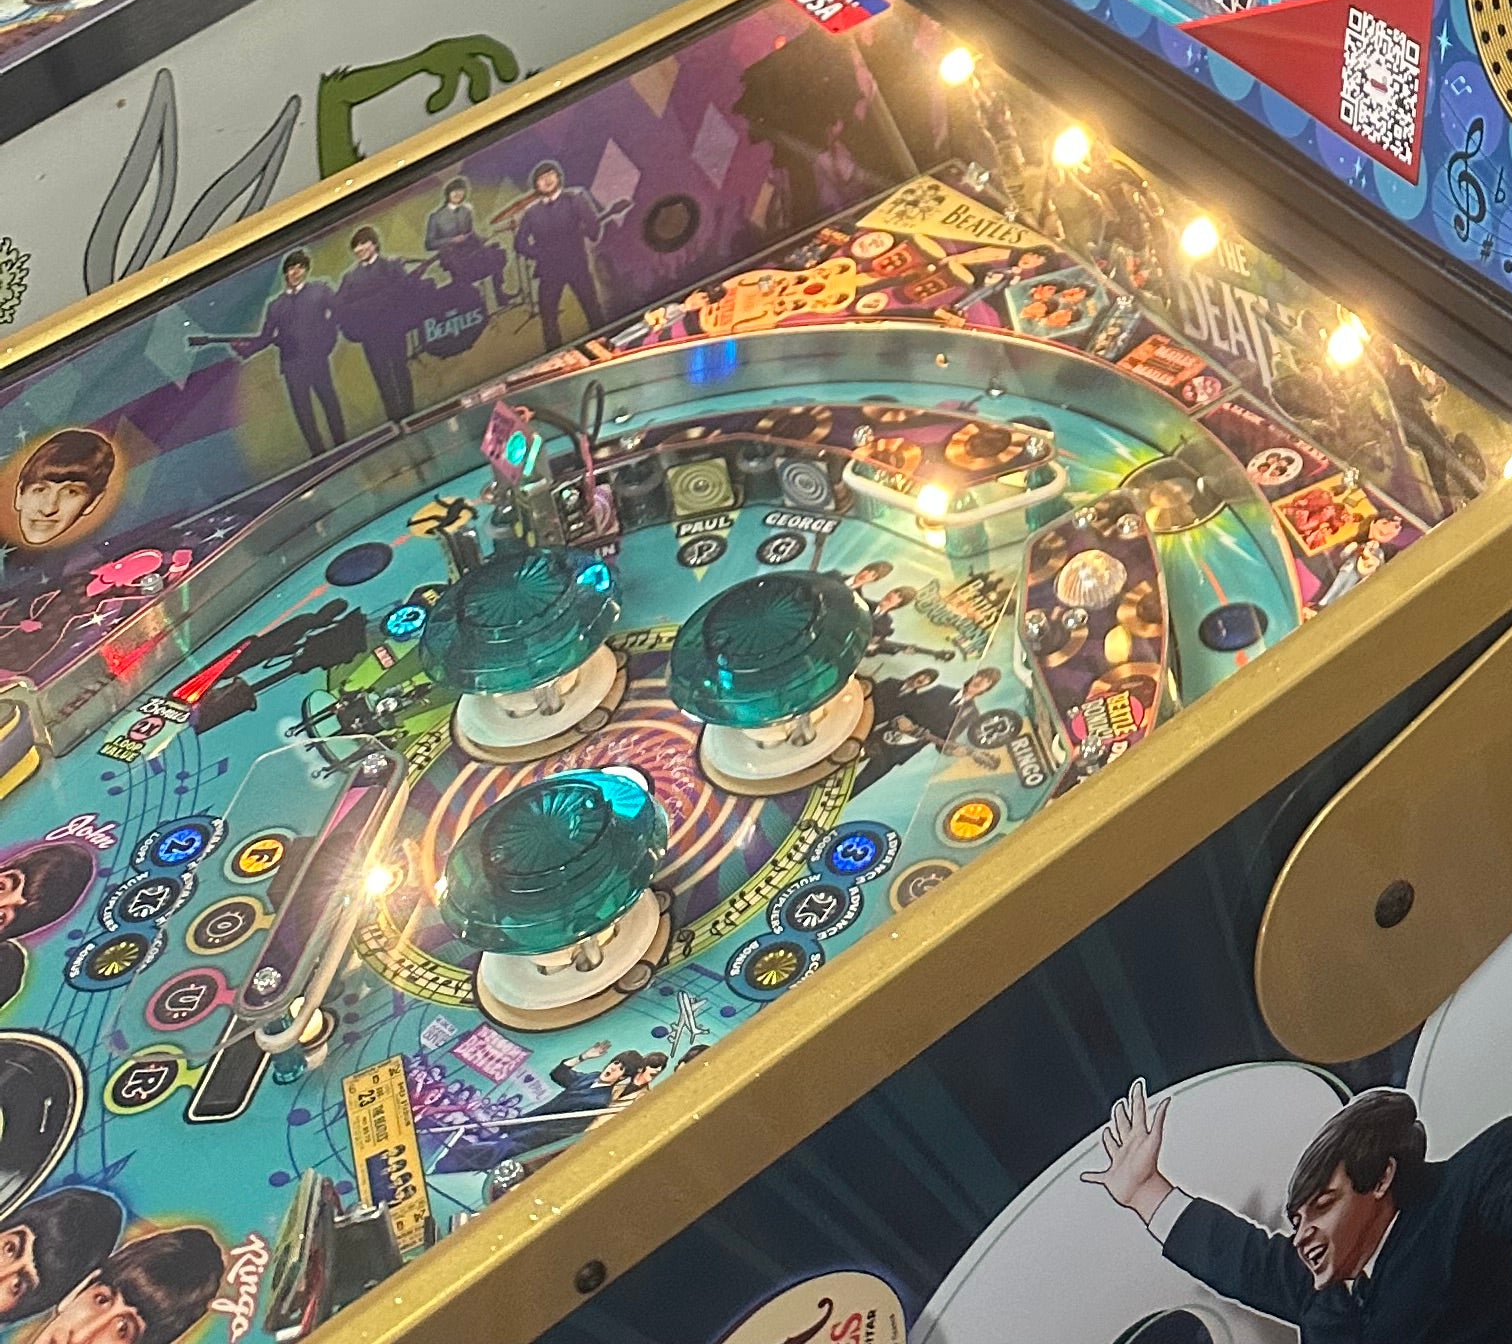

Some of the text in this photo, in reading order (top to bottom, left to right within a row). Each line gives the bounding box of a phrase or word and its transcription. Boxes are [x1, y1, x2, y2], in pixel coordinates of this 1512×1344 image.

[941, 203, 1028, 245] BEATLES
[679, 515, 732, 536] PAUL
[765, 512, 838, 533] GEORGE
[140, 698, 190, 723] Bonus
[100, 743, 141, 761] VALUE
[114, 737, 144, 751] LOOP
[1011, 736, 1045, 786] RINGO
[45, 814, 116, 849] John
[136, 831, 160, 864] LOOPS
[811, 830, 838, 862] LOOPS
[856, 831, 899, 884] ADVANCE
[103, 871, 148, 932] MULTIPLIERS
[771, 873, 822, 934] MULTIPLIERS
[817, 886, 862, 940] ADVANCE
[70, 943, 97, 978] BONUS
[730, 940, 760, 976] BONUS
[358, 1089, 376, 1108] 23
[211, 1234, 269, 1343] Ringo
